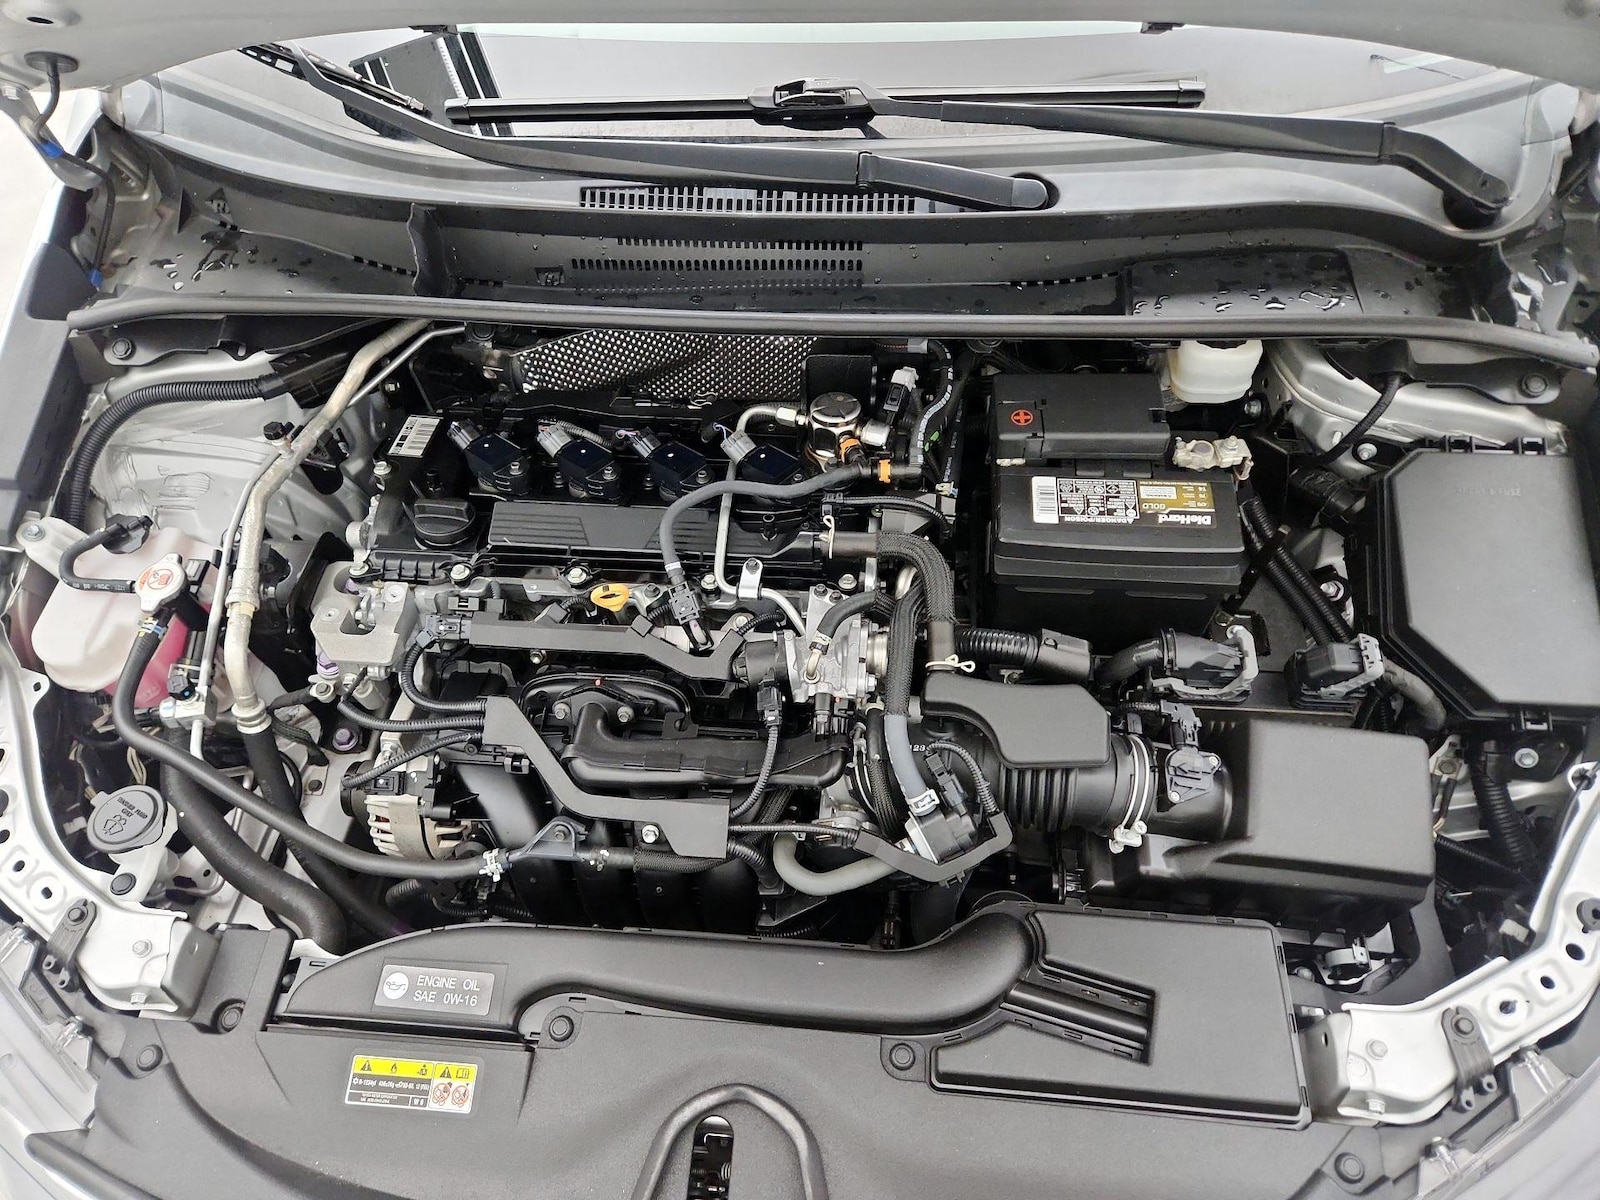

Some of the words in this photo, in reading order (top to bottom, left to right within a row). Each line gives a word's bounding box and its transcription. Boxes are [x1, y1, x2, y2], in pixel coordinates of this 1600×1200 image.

[1142, 502, 1166, 510] GOLD
[1158, 513, 1212, 525] DieHard
[416, 974, 457, 989] ENGINE
[462, 979, 481, 992] OIL
[413, 989, 437, 1003] SAE
[443, 992, 478, 1007] 0W-16
